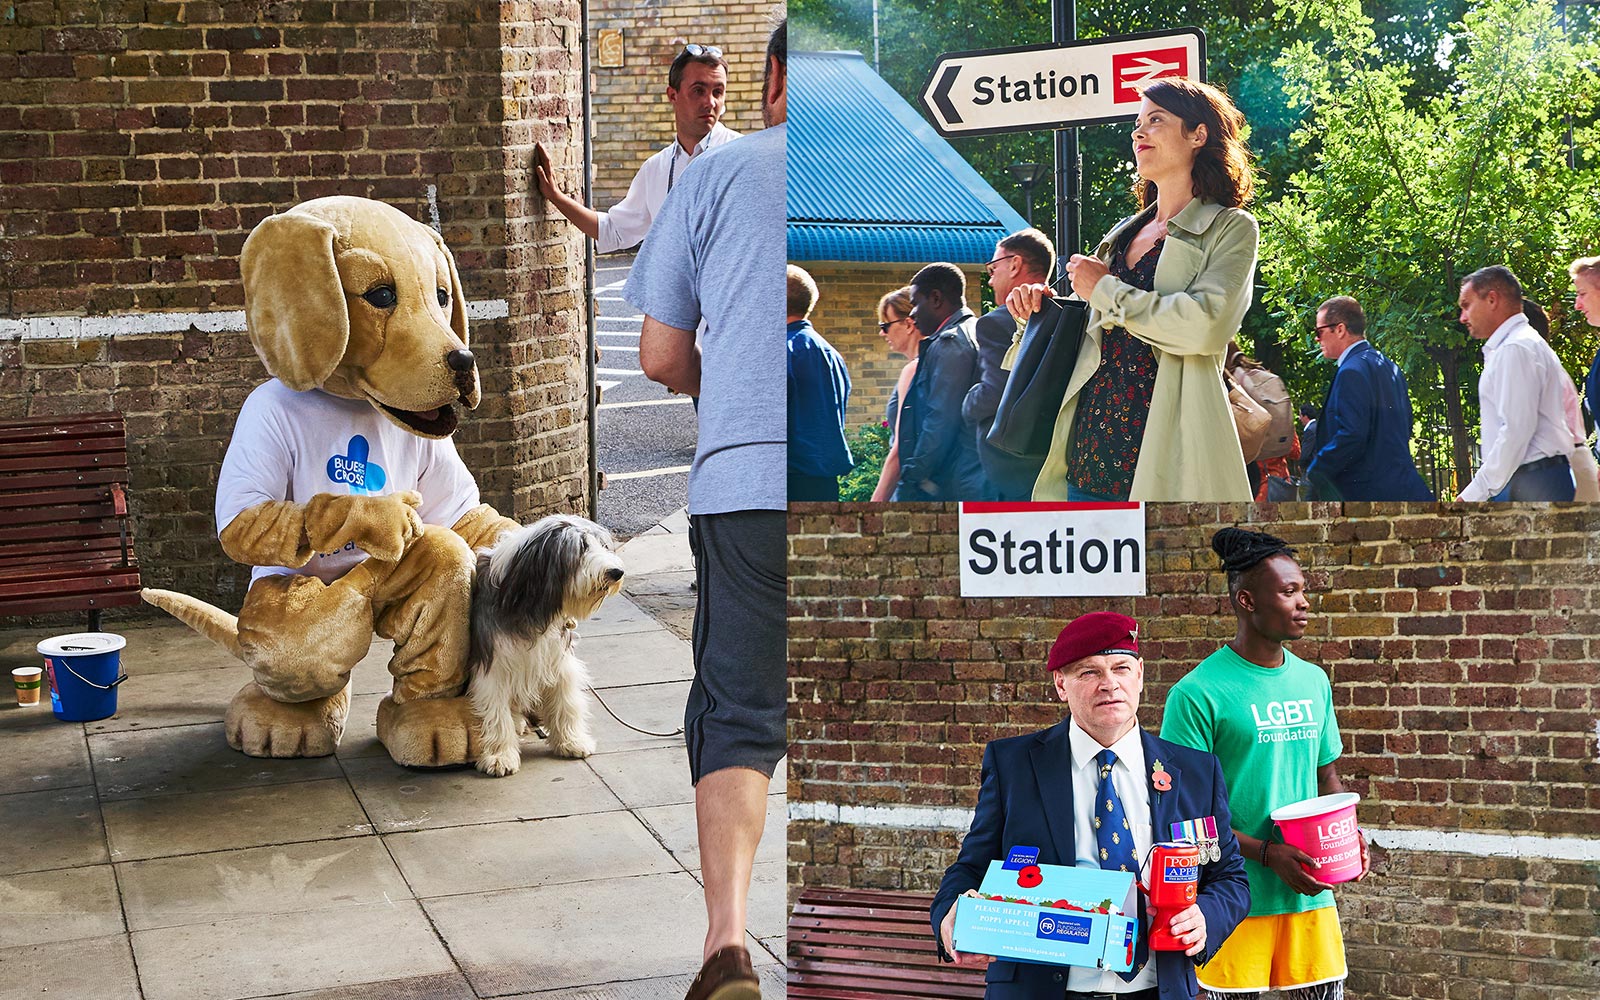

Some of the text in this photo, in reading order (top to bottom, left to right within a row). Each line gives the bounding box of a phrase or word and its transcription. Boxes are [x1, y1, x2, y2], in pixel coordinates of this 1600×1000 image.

[972, 70, 1099, 106] Station
[334, 457, 360, 473] BLUE
[334, 469, 365, 486] CROSS
[968, 527, 1141, 575] Station
[1250, 699, 1314, 727] LGBT
[1257, 727, 1319, 744] foundation
[1317, 815, 1356, 841] LGBT
[974, 904, 1038, 918] PLEASE HELP THE
[979, 915, 1030, 927] POPPY APPEAL
[1042, 922, 1053, 931] FR
[1056, 928, 1089, 938] REGULATOR
